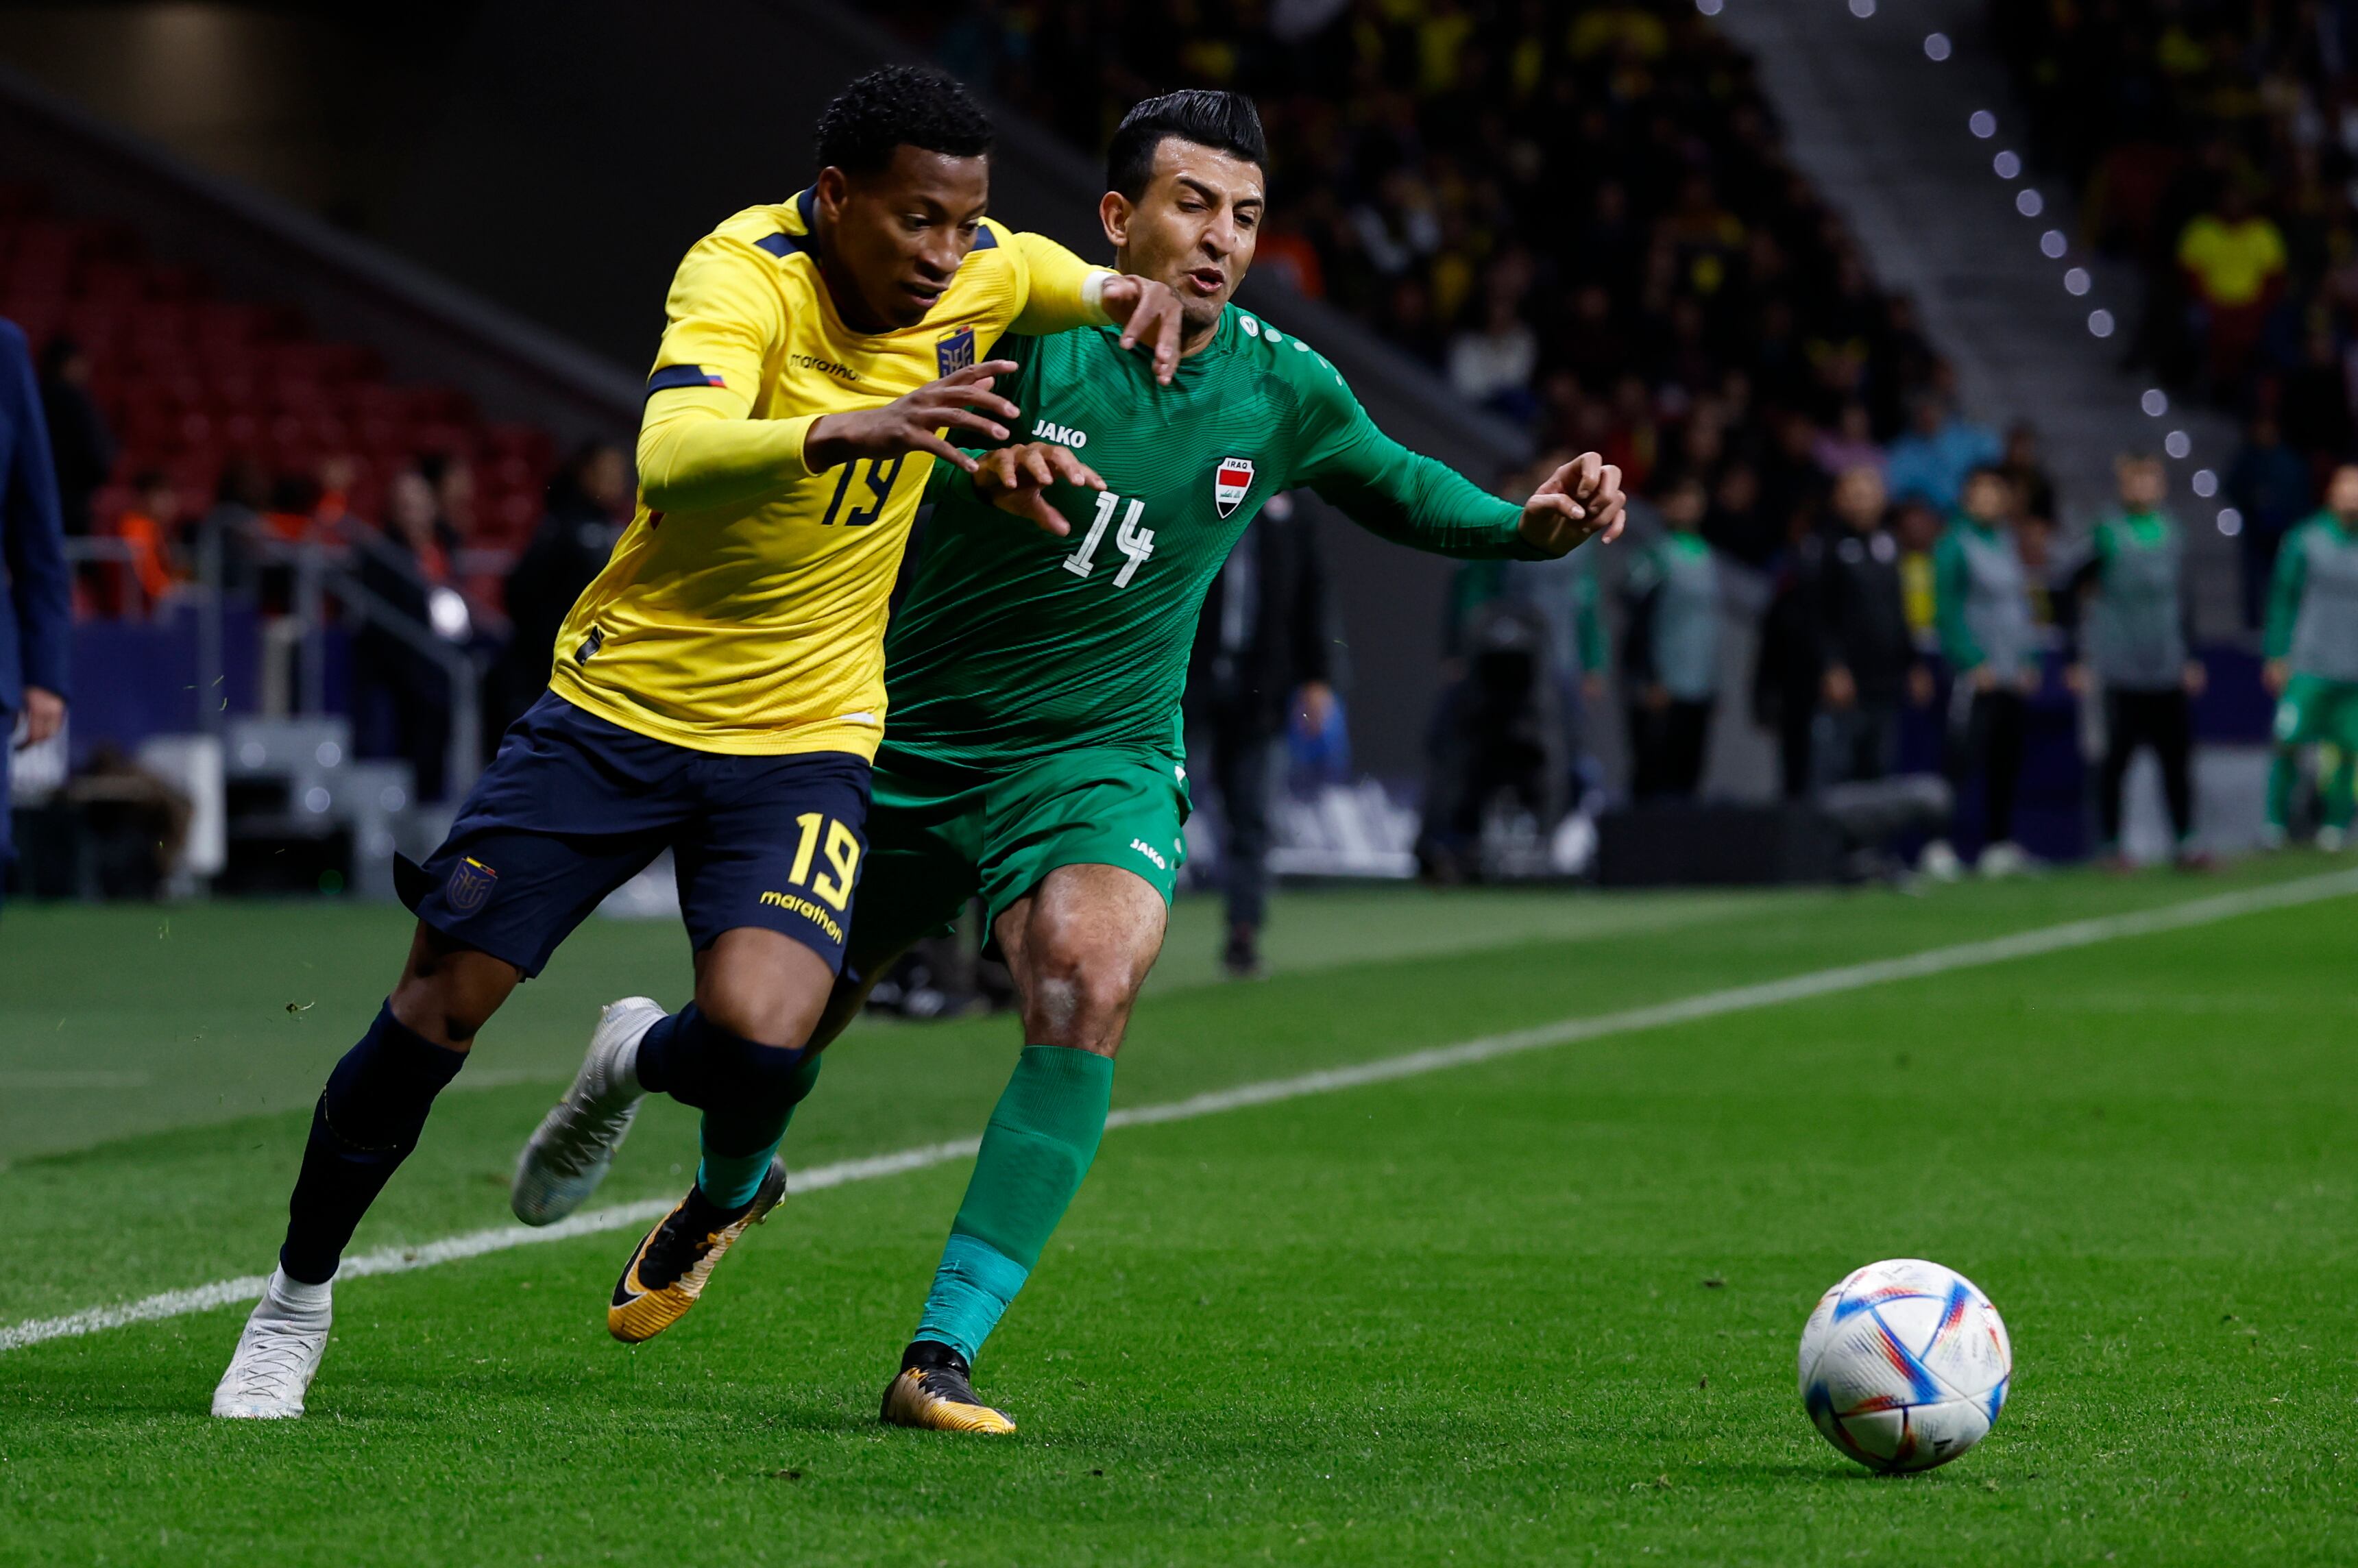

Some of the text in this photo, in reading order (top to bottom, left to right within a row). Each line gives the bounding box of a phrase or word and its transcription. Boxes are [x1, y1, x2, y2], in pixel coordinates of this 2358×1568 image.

[1031, 419, 1086, 448] JAKO
[821, 454, 904, 526] 19
[1226, 461, 1248, 469] IRAQ
[1062, 491, 1155, 589] 14
[788, 812, 860, 911] 19
[1130, 838, 1165, 870] JAKO
[759, 891, 843, 944] marathon
